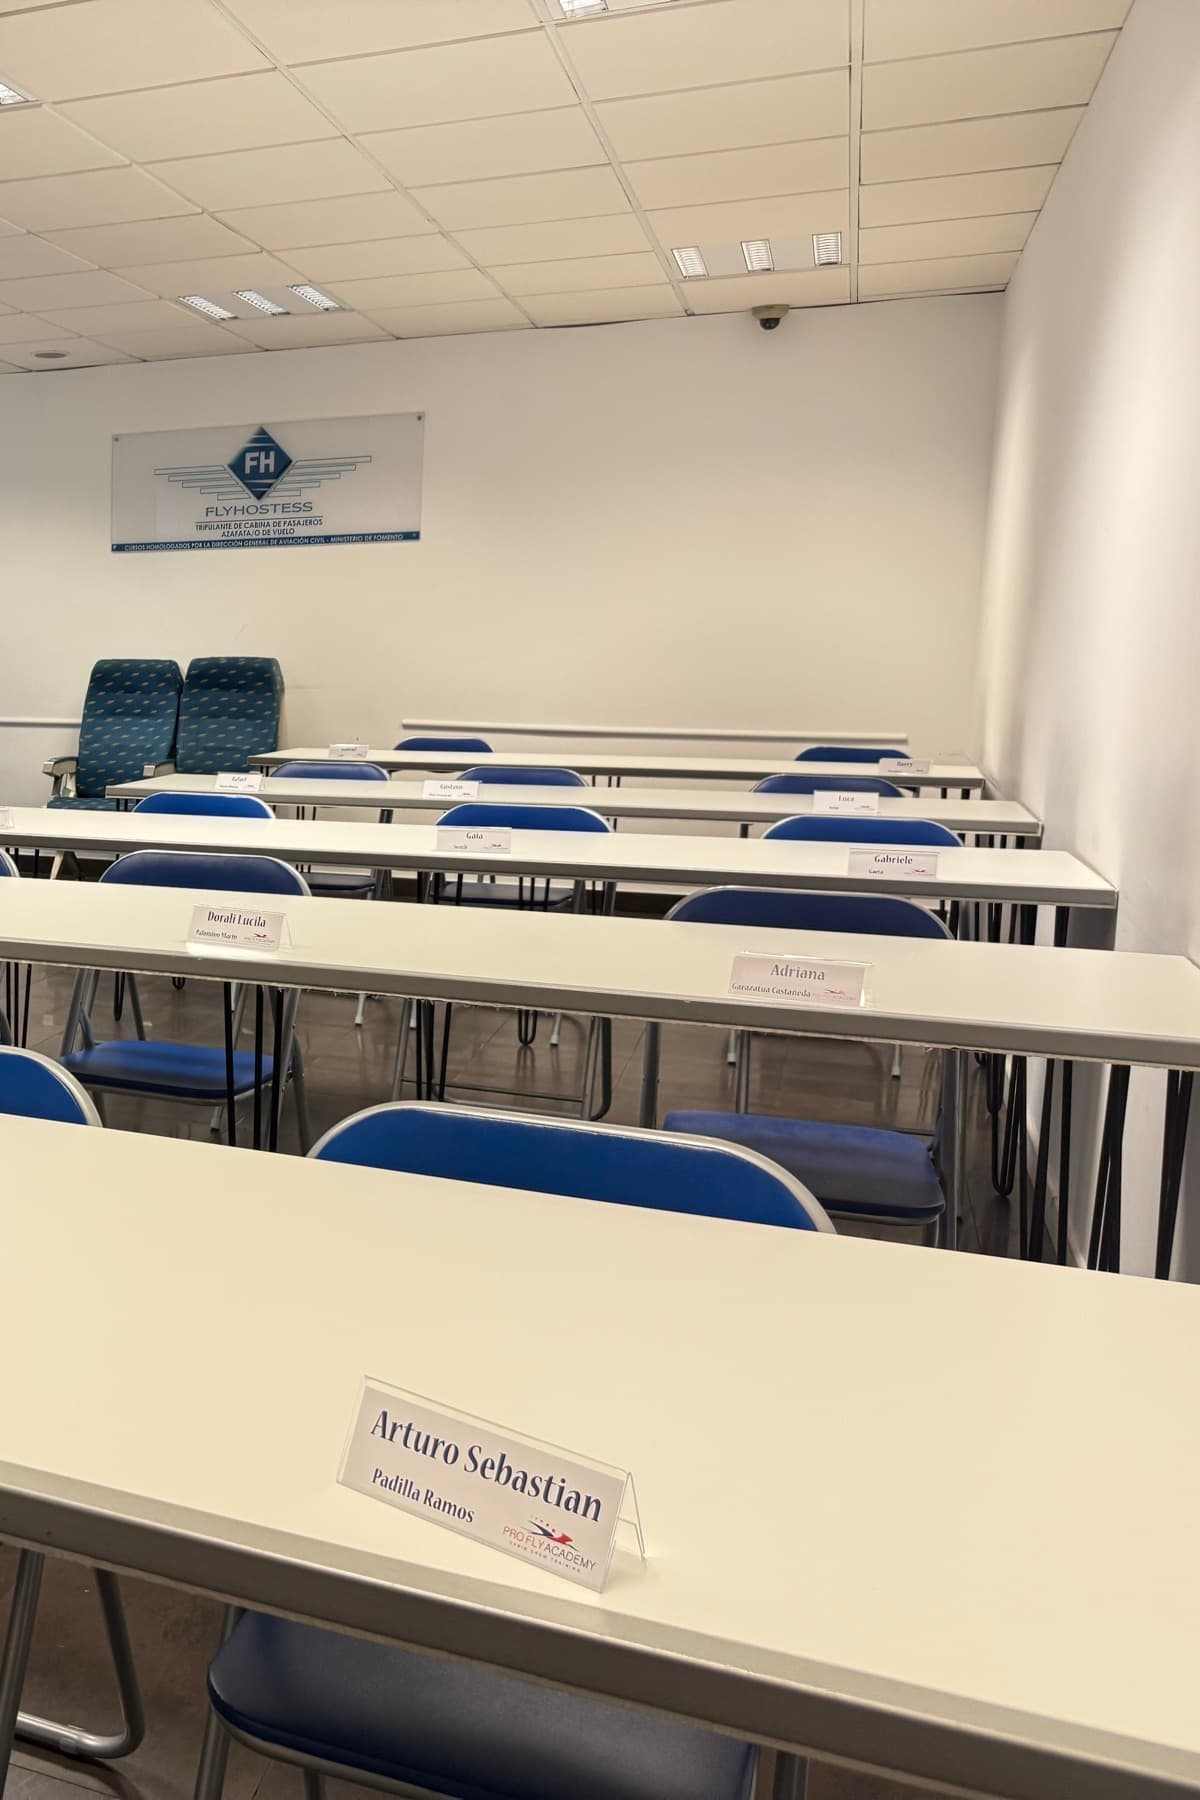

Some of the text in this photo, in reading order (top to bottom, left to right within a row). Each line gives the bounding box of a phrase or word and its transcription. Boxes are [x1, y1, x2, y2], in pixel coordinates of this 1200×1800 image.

[244, 451, 275, 474] FH
[205, 502, 313, 516] FLYHOSTESS
[196, 522, 232, 531] TRIPULANTE
[244, 520, 271, 529] CABINA
[283, 519, 322, 527] PASAJEROS
[222, 529, 260, 537] AZAFATA/O
[874, 855, 912, 864] Gabriele
[207, 911, 266, 927] Dorali Lucila
[770, 964, 825, 981] Adriana
[370, 1410, 601, 1522] Arturo Sebastian
[372, 1467, 475, 1524] Padilla Ramos
